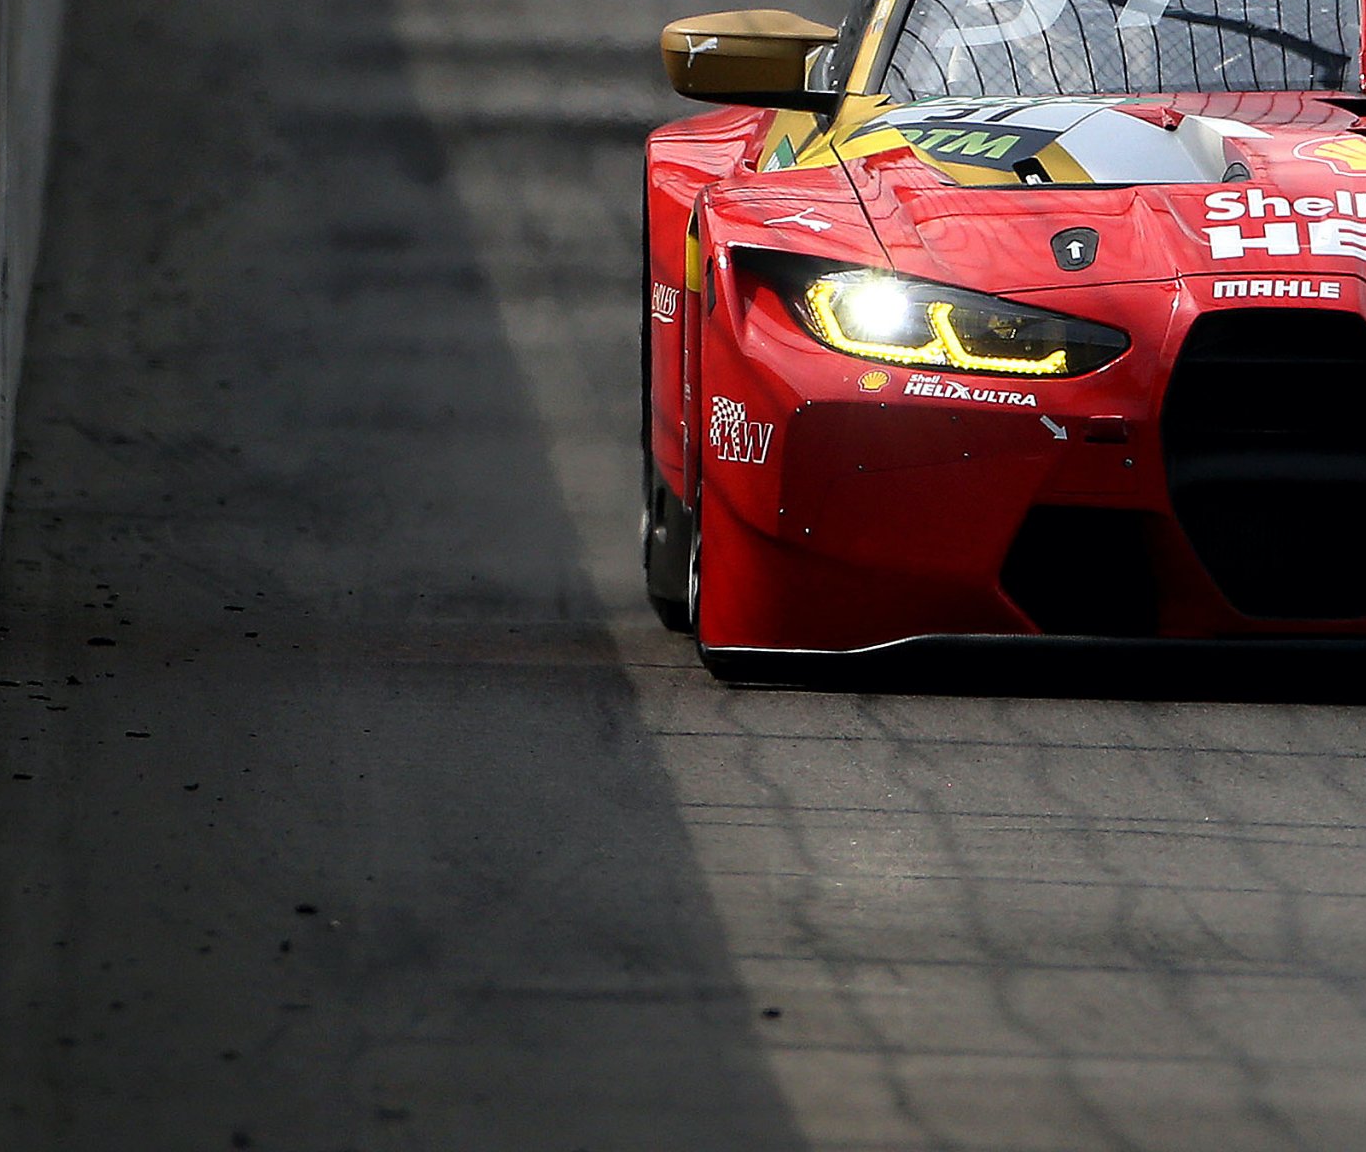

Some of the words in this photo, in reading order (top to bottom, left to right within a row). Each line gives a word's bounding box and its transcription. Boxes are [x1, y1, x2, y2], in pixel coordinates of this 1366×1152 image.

[1213, 280, 1340, 299] MAHLE
[910, 374, 940, 384] Shell
[971, 389, 1037, 407] ULTRA
[718, 418, 774, 464] KW
